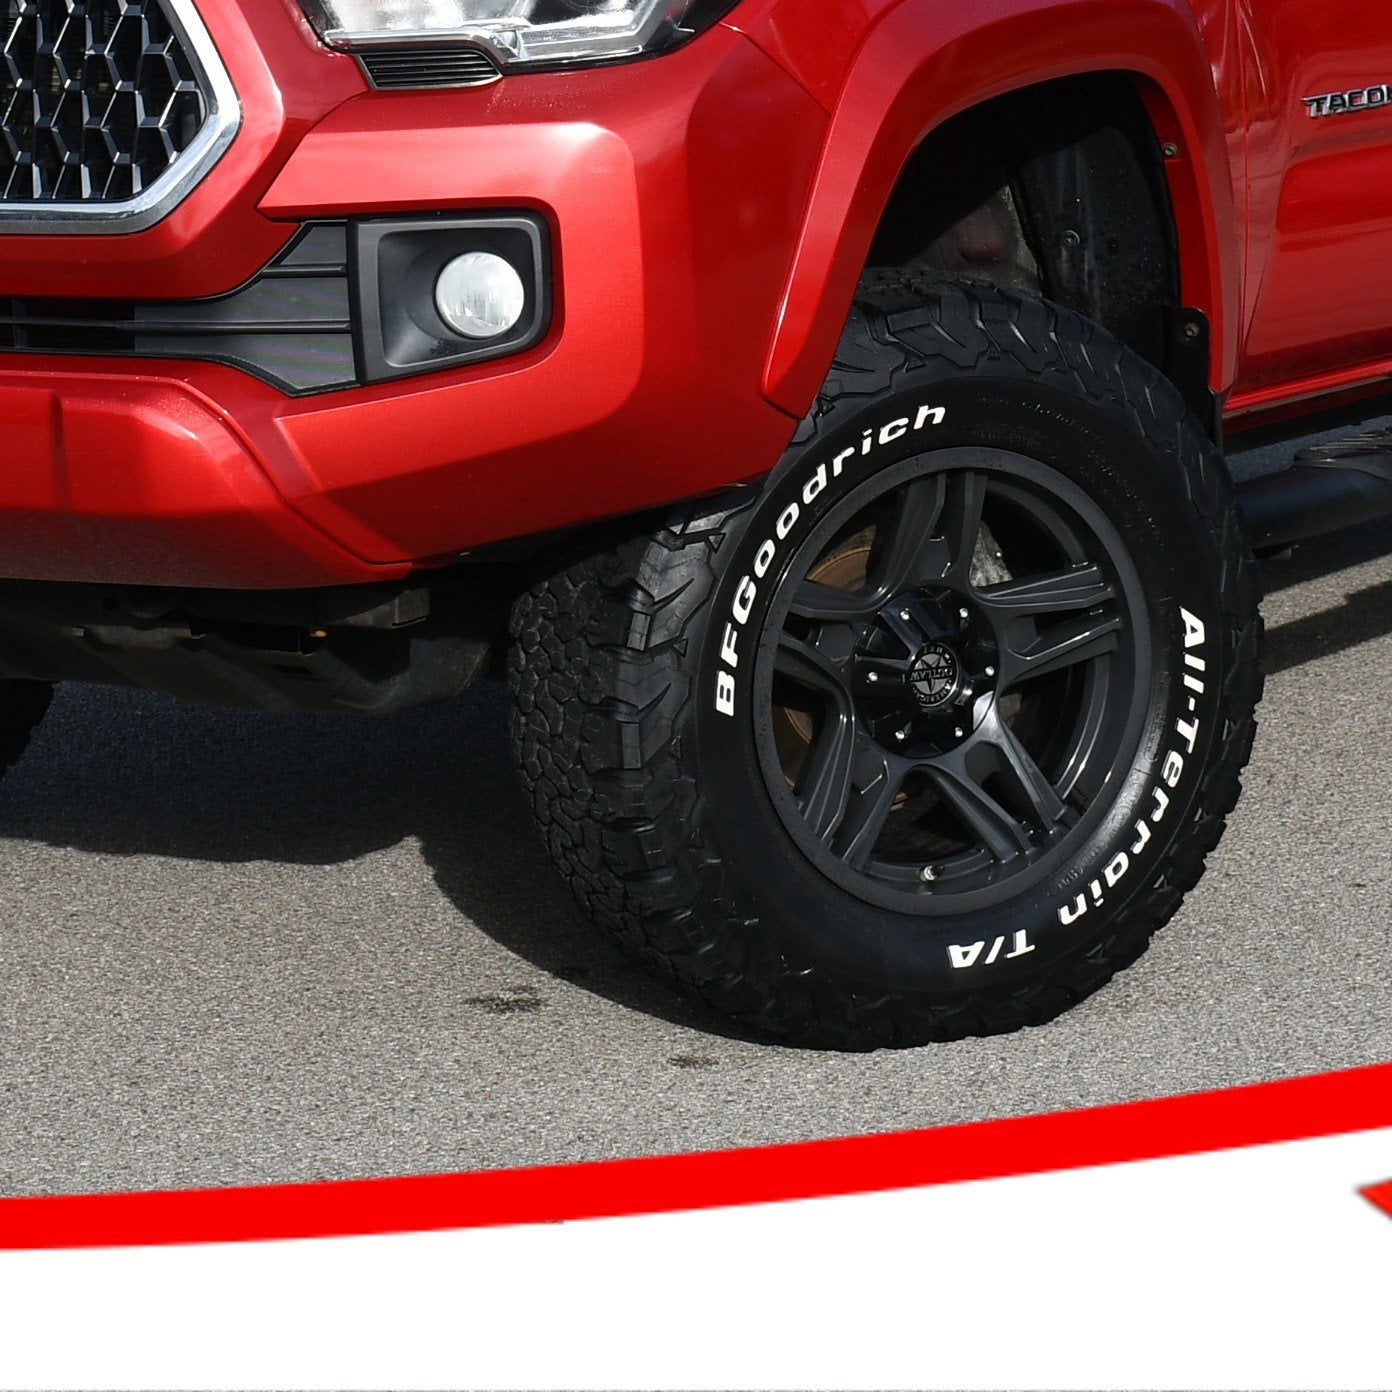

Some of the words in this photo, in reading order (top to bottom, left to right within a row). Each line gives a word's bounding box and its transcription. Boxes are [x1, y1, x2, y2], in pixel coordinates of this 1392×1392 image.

[715, 404, 946, 718] BFGoodrich
[1058, 607, 1206, 925] All-Terrain
[948, 929, 1036, 969] T/A
